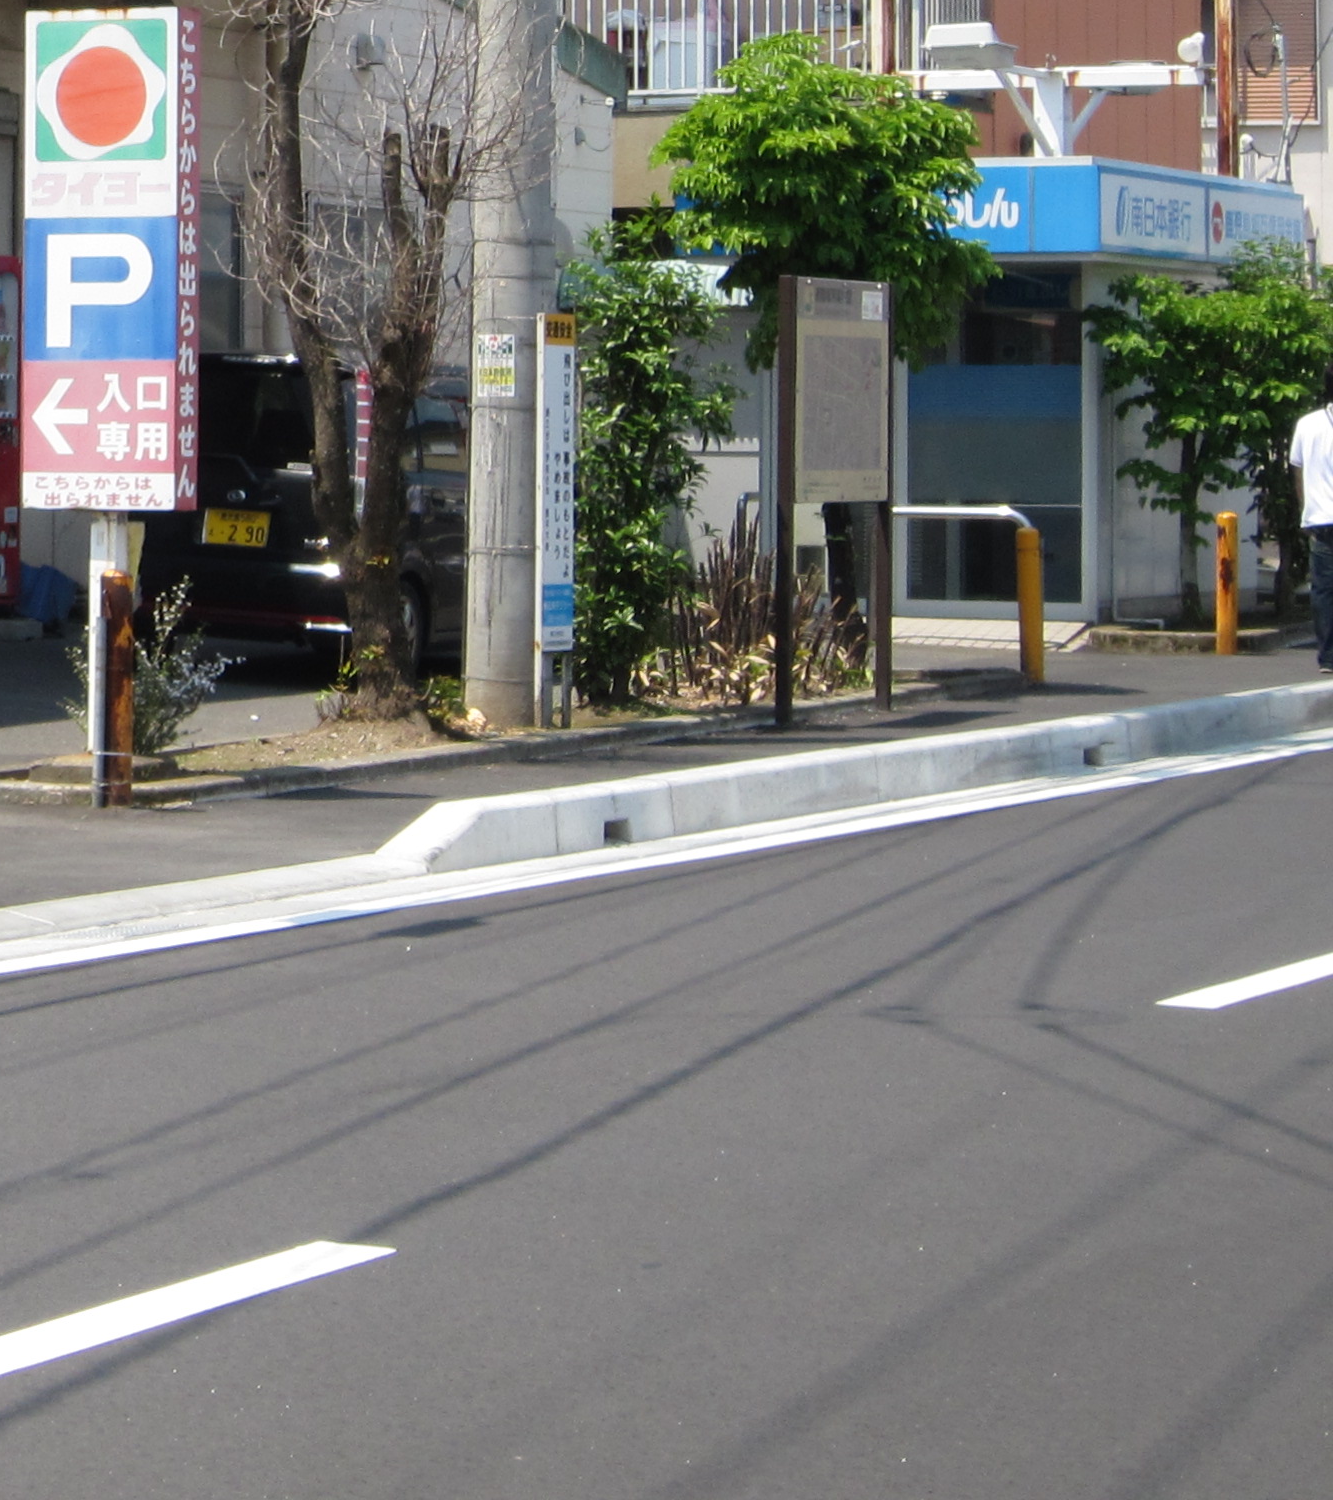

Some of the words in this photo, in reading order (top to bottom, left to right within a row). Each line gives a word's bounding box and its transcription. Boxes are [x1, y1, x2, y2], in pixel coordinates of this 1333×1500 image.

[31, 171, 171, 207] タイヨー
[178, 19, 198, 499] こちらからは出られません
[45, 232, 154, 349] P
[96, 372, 168, 413] 入口
[95, 421, 168, 462] 専用
[35, 475, 152, 491] こちらからは
[44, 491, 164, 508] 出られません
